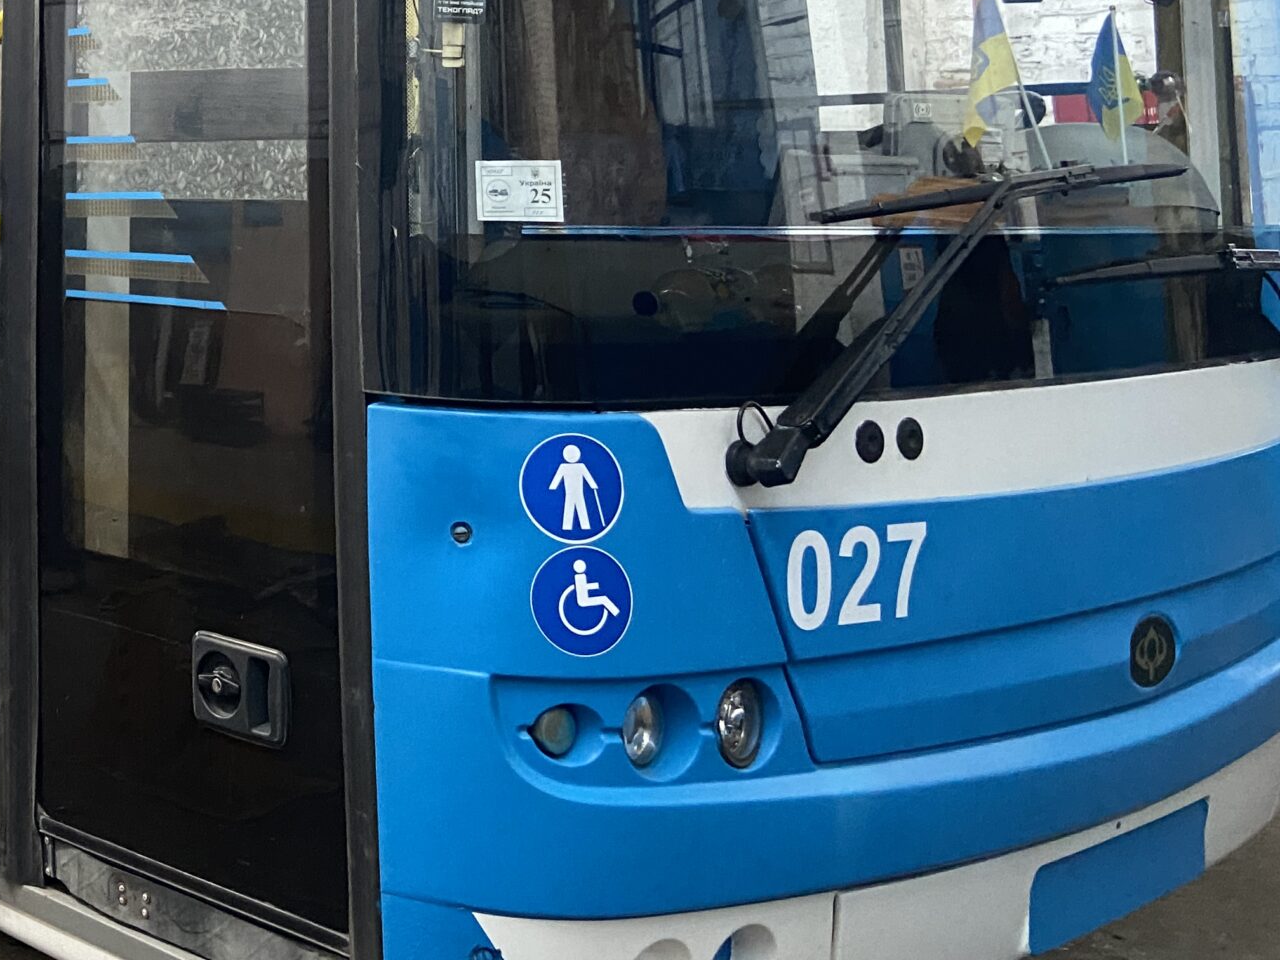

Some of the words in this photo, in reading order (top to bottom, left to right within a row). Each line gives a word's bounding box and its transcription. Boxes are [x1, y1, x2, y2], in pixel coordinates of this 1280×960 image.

[519, 180, 553, 188] Україна
[530, 188, 552, 204] 25
[786, 521, 927, 631] 027
